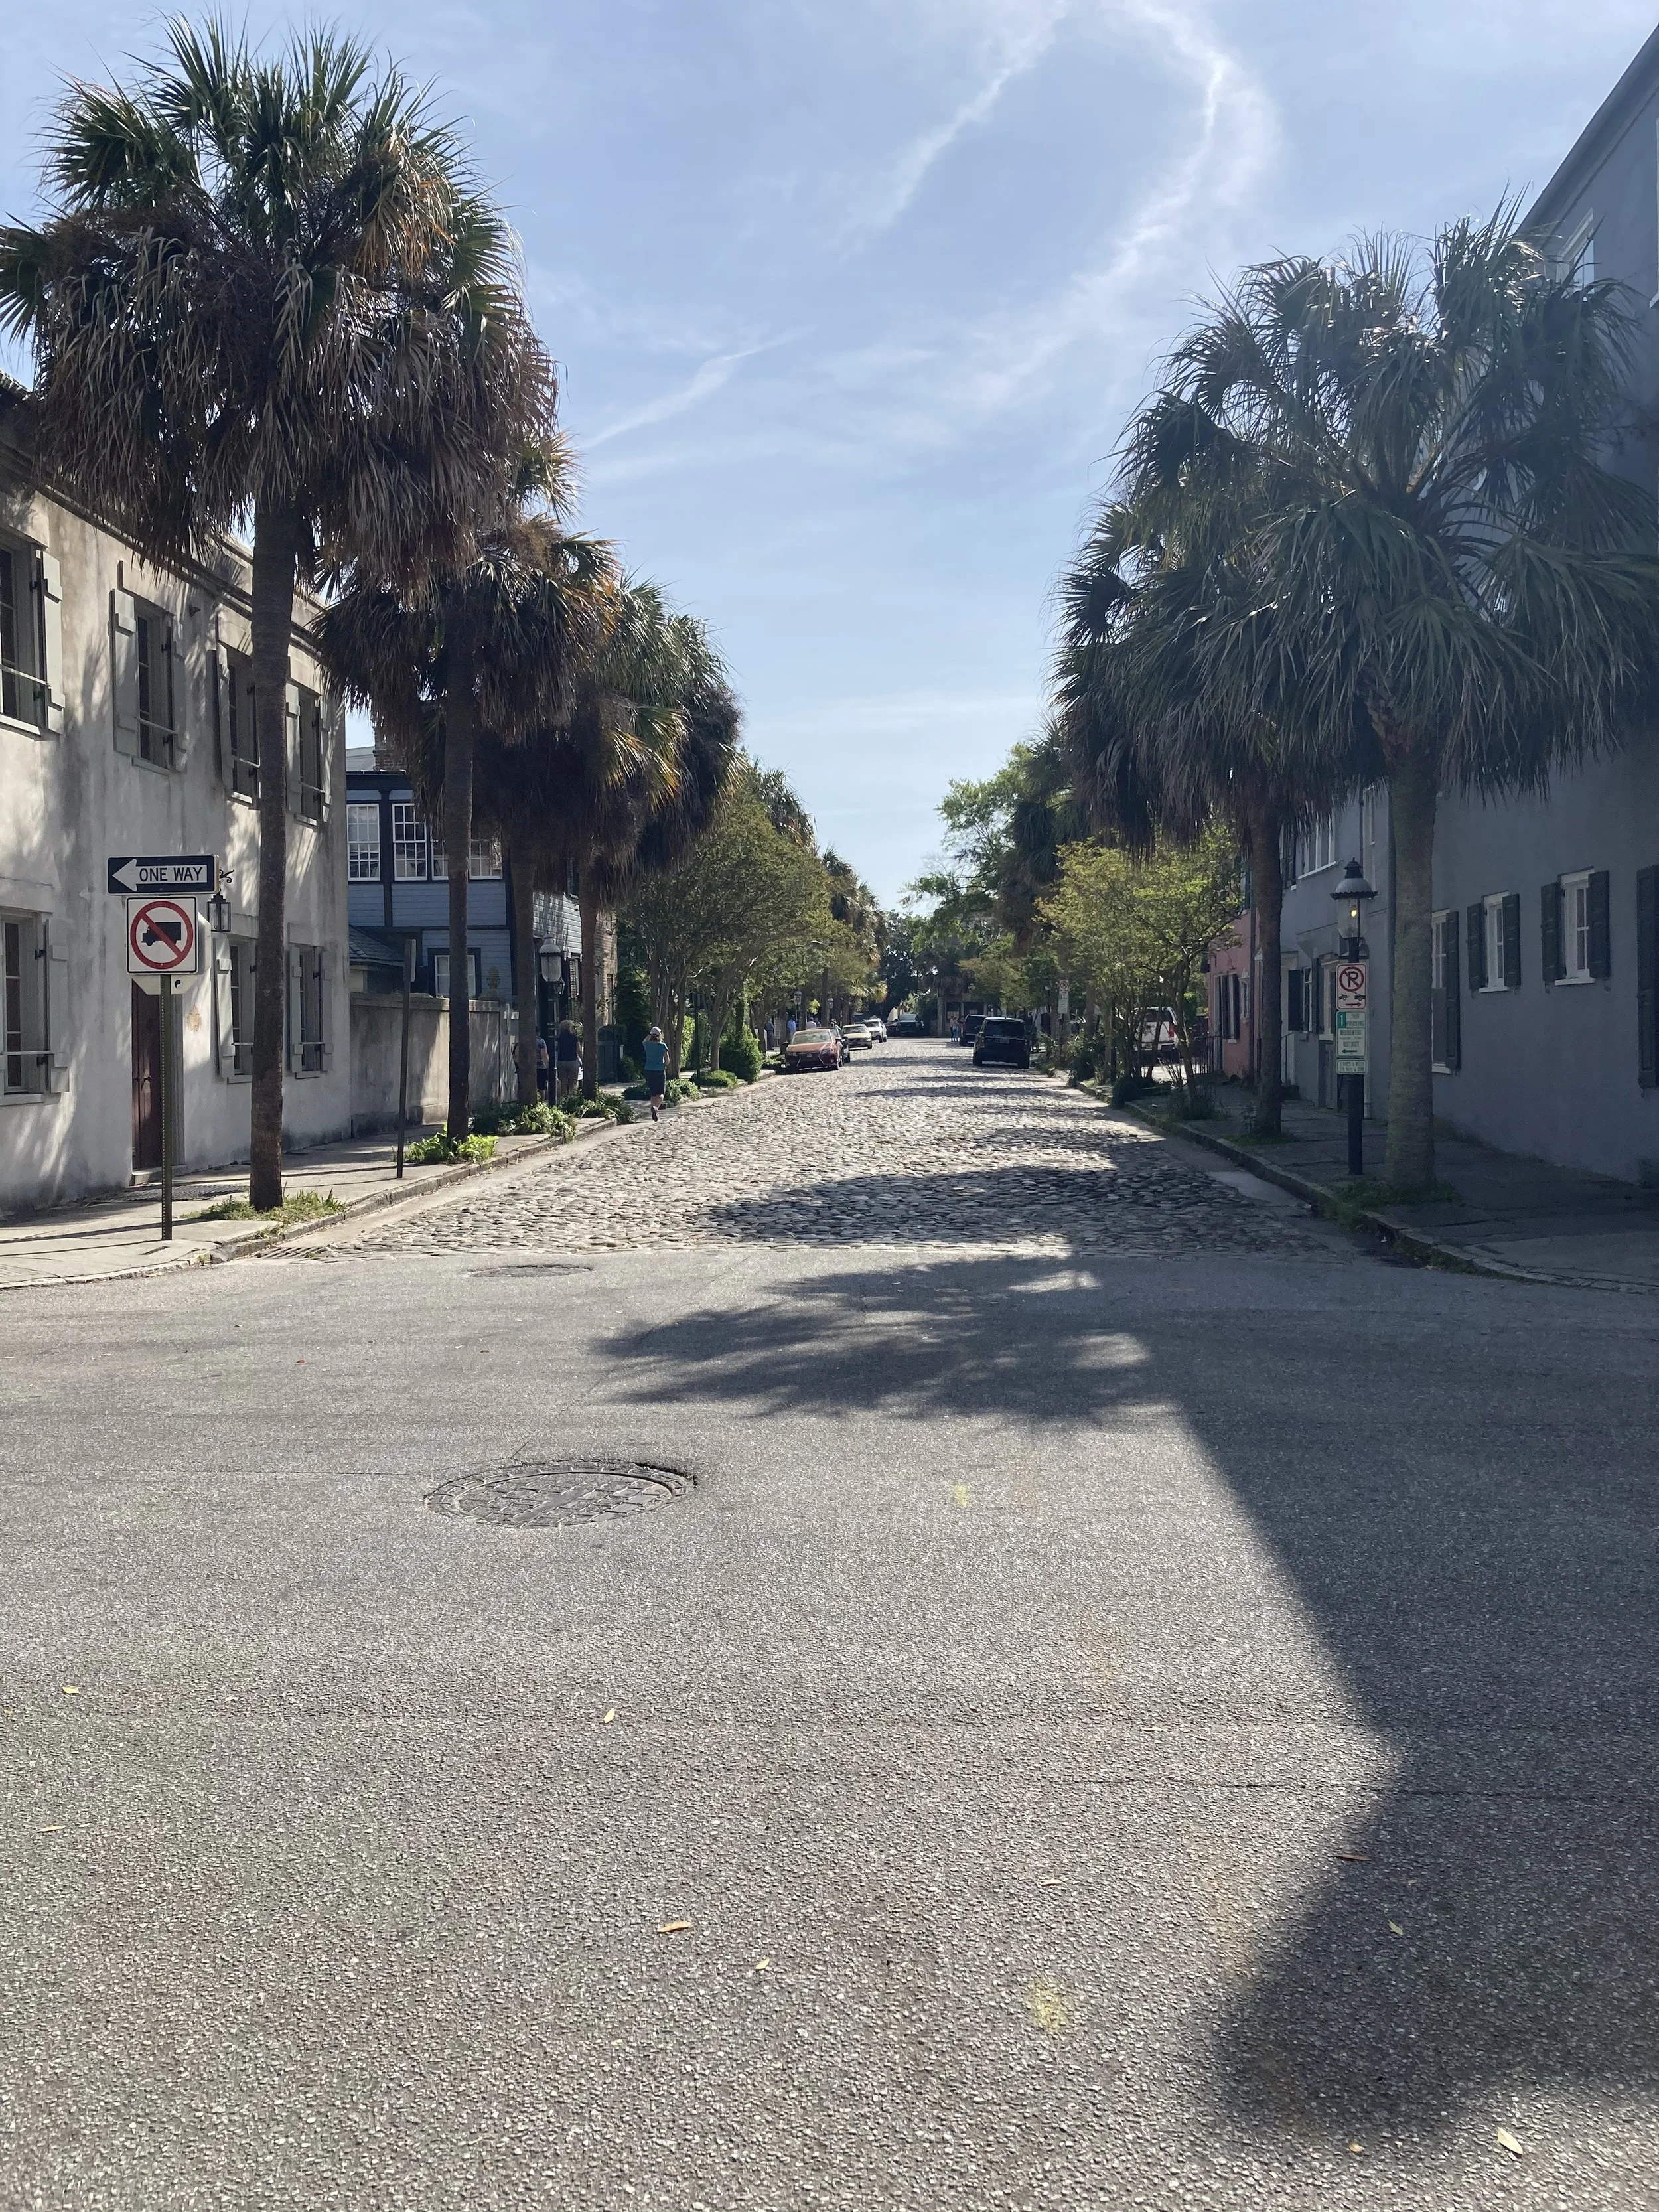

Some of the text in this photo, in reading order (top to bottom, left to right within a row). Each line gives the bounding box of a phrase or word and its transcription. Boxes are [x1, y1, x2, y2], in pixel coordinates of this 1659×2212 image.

[139, 867, 202, 882] ONE WAY
[1340, 1015, 1343, 1026] 1
